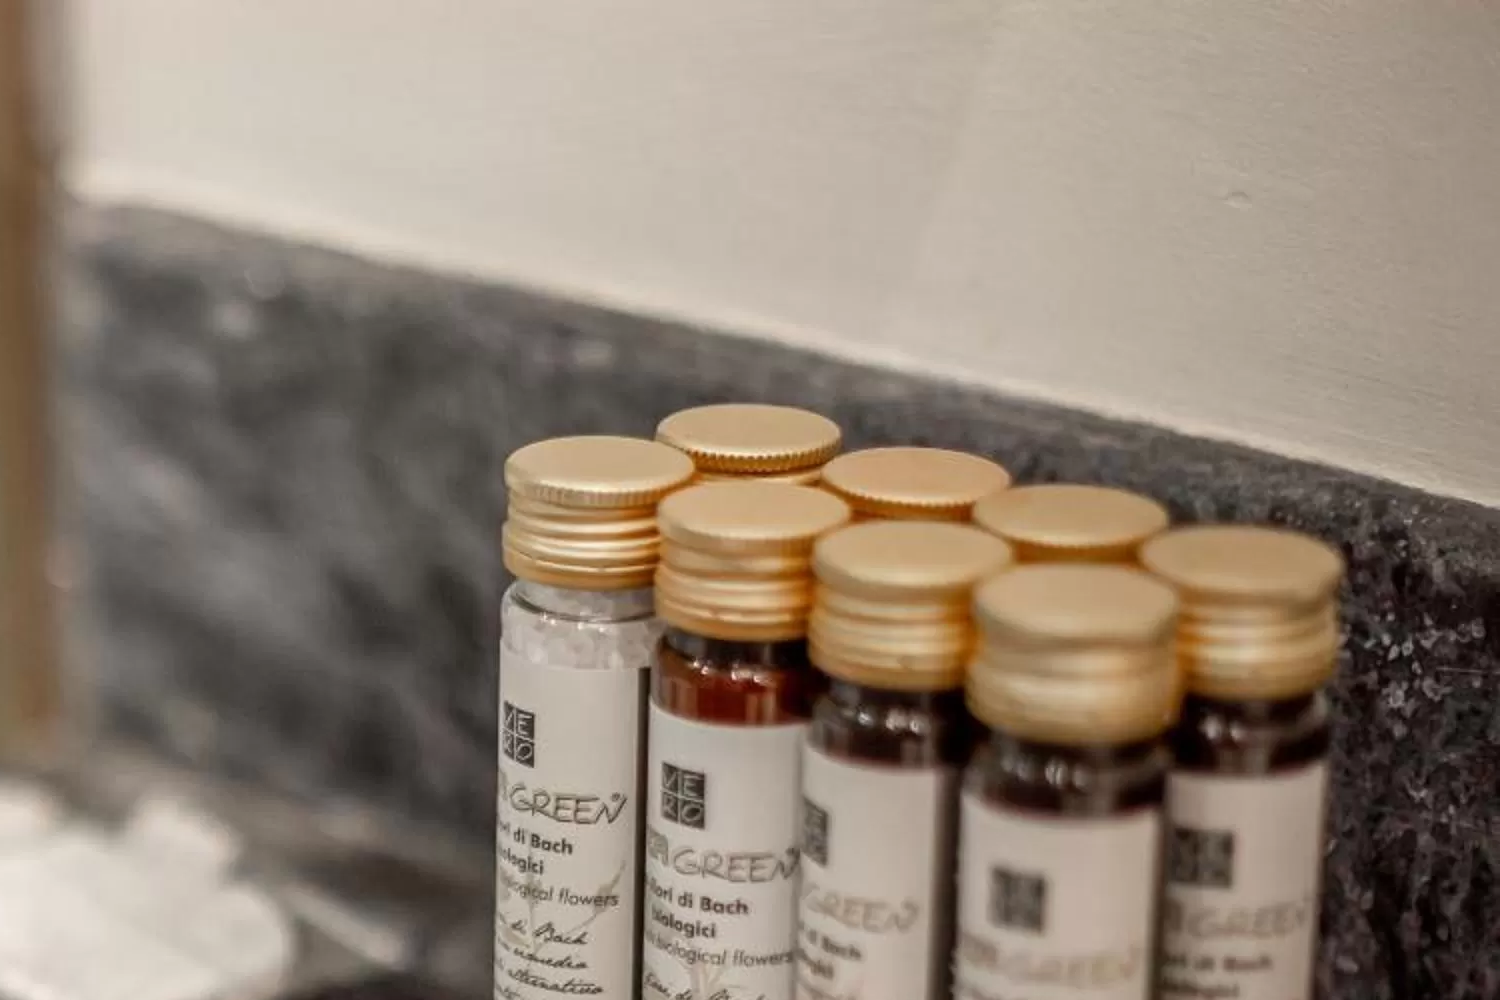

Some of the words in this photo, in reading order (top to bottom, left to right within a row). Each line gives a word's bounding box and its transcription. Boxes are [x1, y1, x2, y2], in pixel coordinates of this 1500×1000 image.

[530, 833, 573, 855] Bach
[559, 887, 620, 907] flowers
[678, 891, 694, 909] di
[700, 895, 750, 916] Bach
